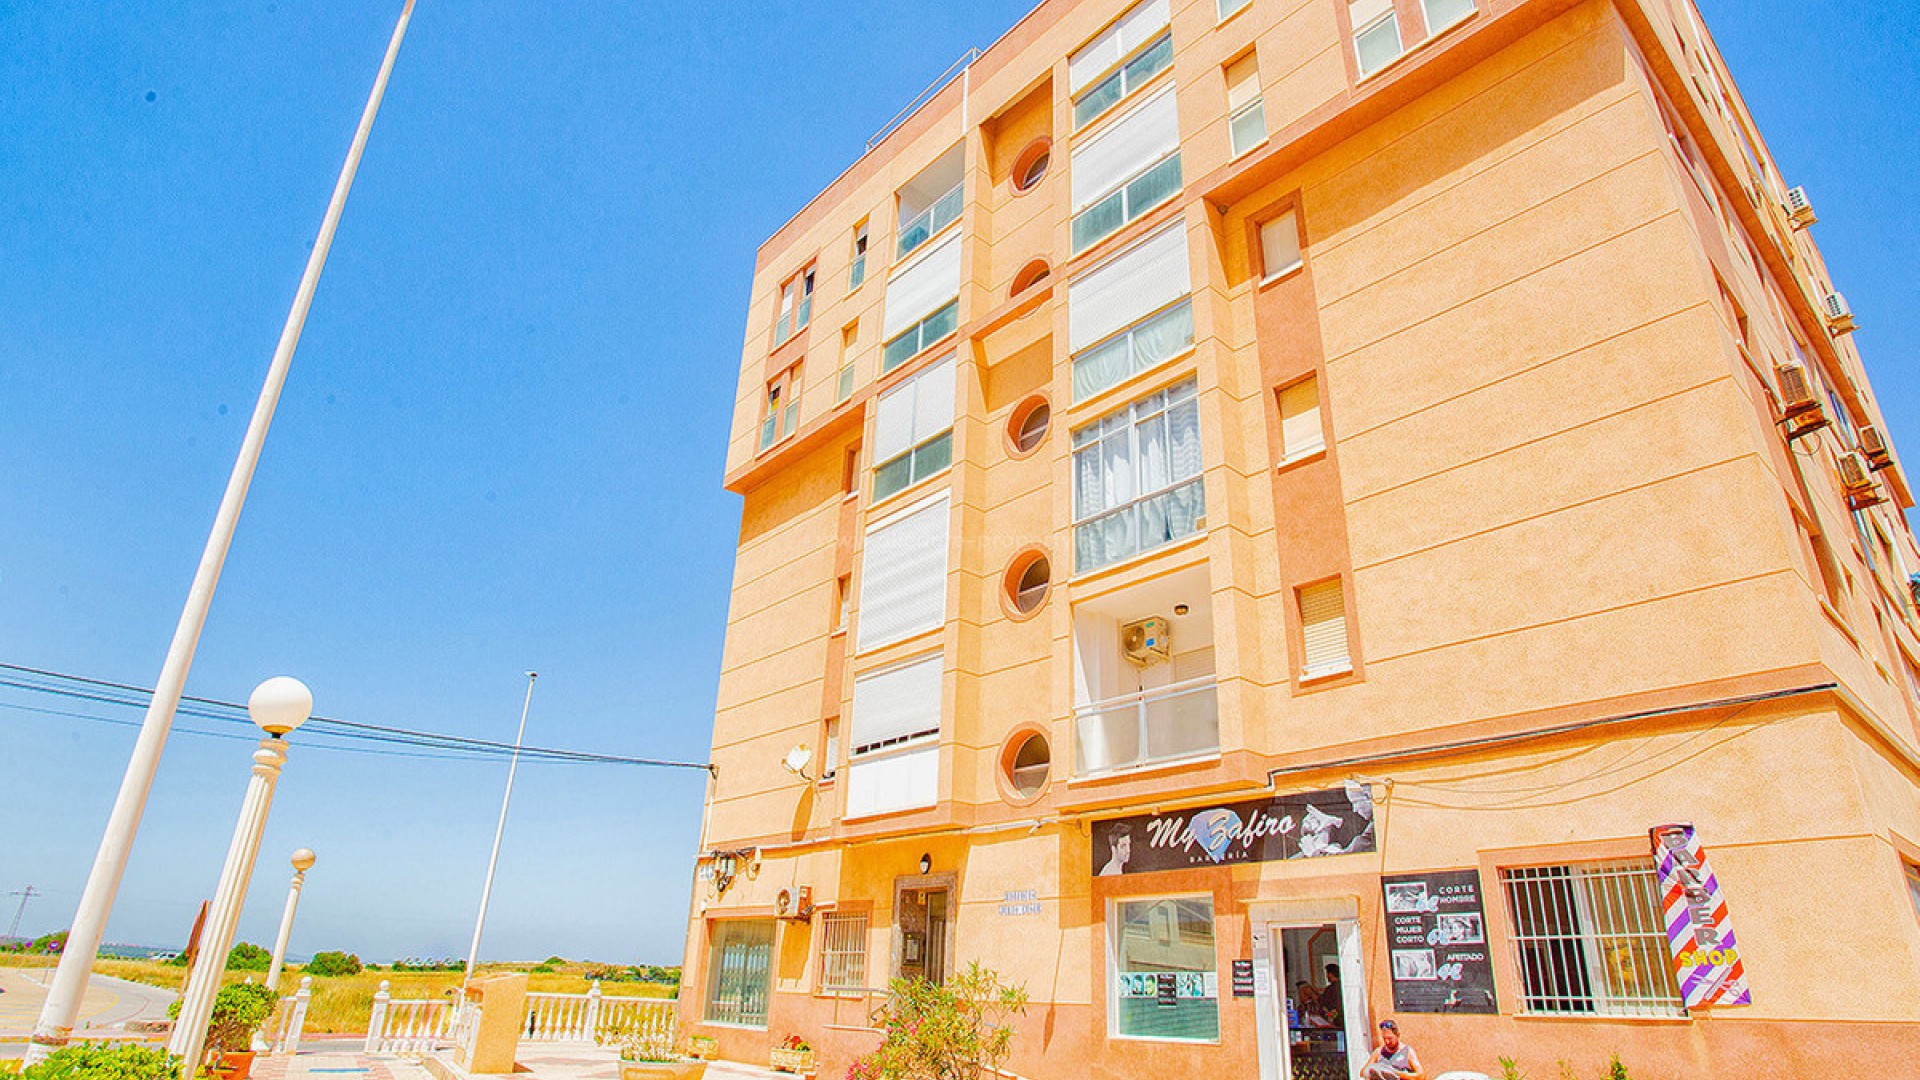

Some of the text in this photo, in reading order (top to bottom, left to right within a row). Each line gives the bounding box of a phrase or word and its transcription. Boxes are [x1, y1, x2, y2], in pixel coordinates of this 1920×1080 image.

[1146, 809, 1296, 853] My Zafiro
[1189, 851, 1249, 864] BARERÍA
[1438, 884, 1475, 894] CORTE
[1660, 830, 1720, 946] BARBER
[1439, 895, 1476, 904] HOMBRE
[1394, 916, 1422, 925] CORTE
[1396, 935, 1425, 944] CORTO
[1679, 948, 1738, 968] SHOP
